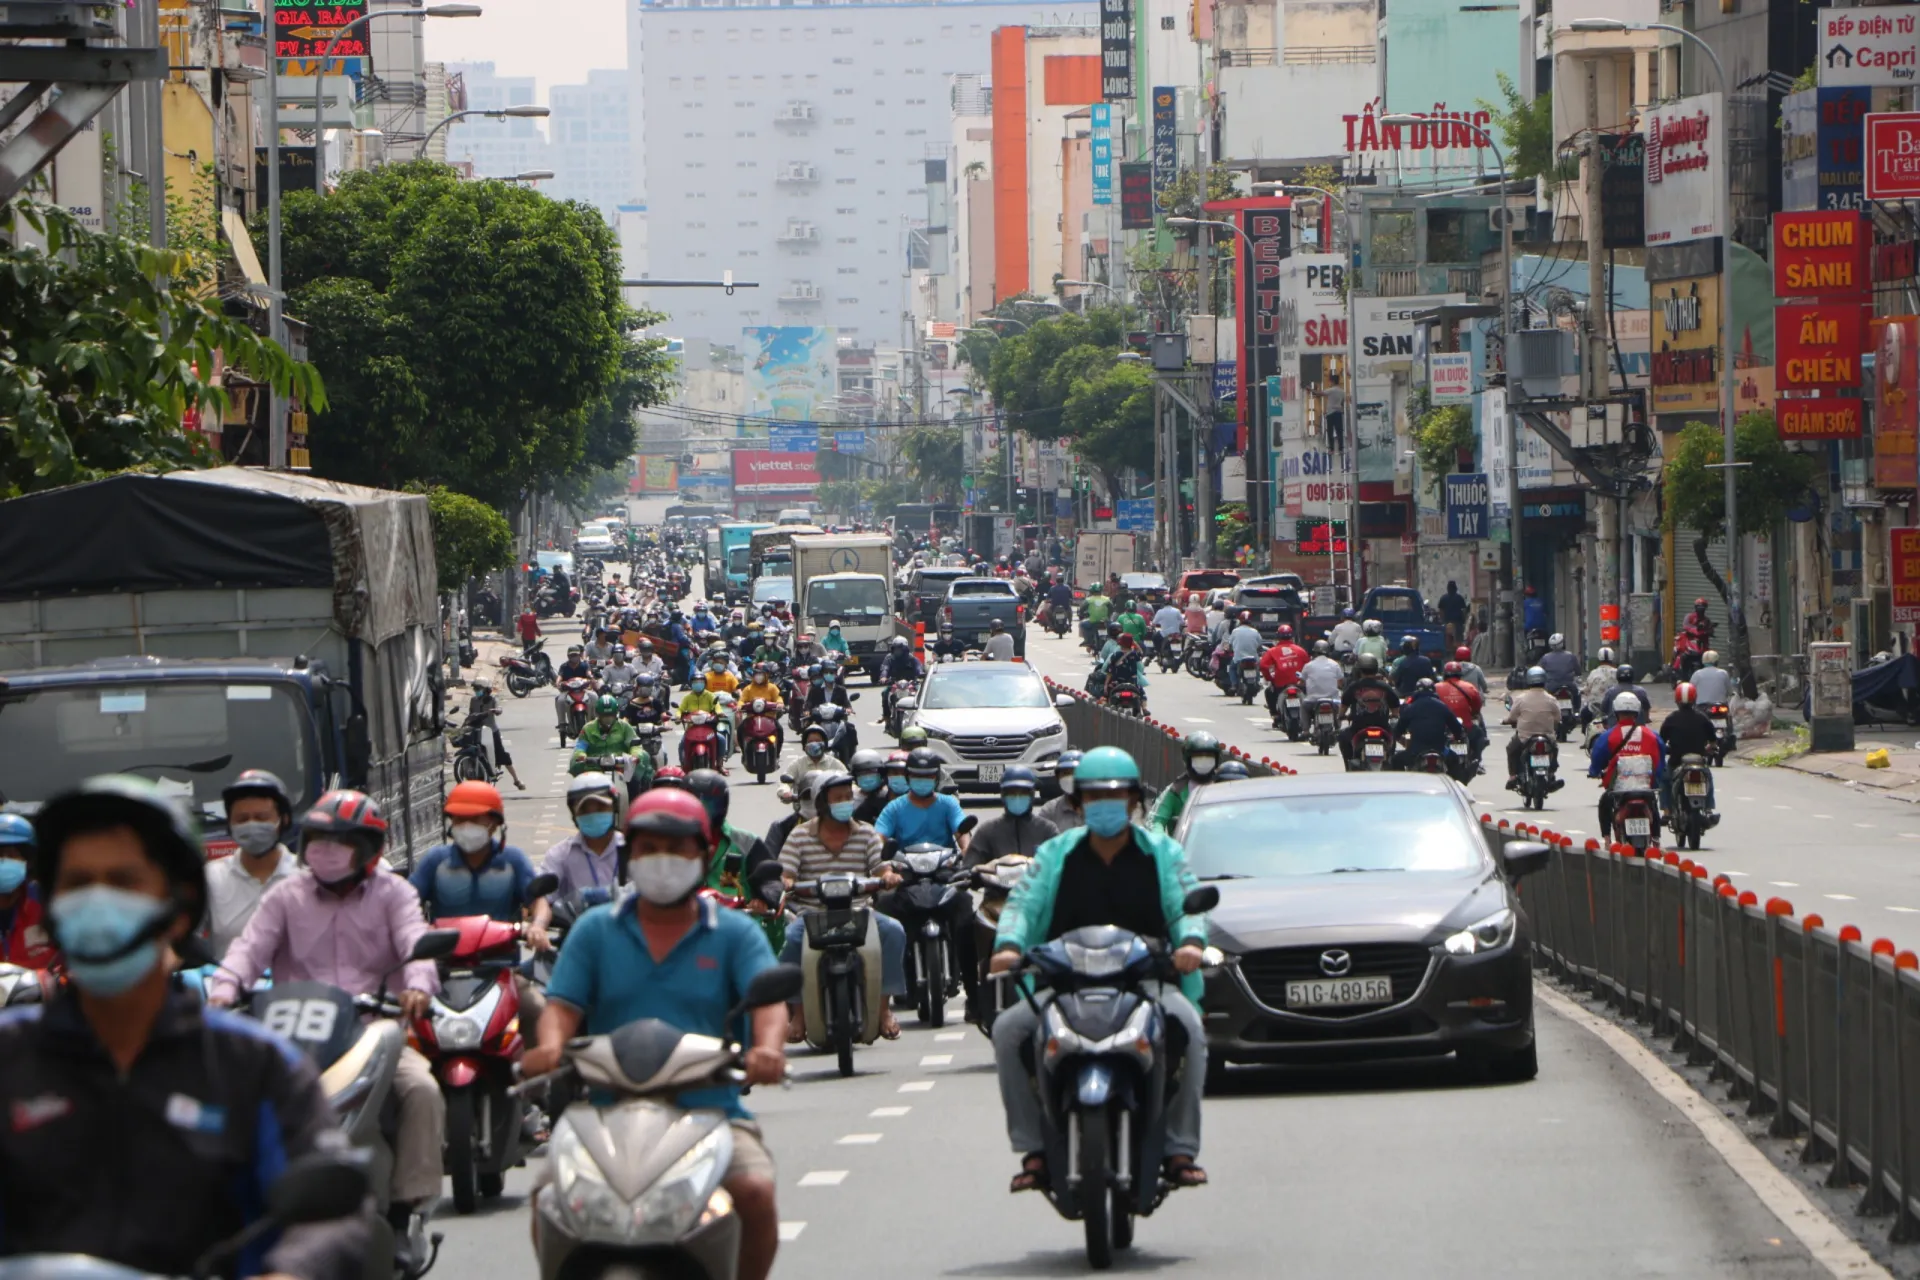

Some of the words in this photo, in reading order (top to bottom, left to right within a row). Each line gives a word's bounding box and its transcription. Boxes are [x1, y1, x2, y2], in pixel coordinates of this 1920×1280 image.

[275, 11, 313, 25] GIA
[318, 6, 360, 25] BẢO
[1828, 14, 1854, 37] BẾP
[1858, 15, 1892, 38] ĐIỆN
[1856, 45, 1916, 71] Capri
[1103, 77, 1129, 94] LONG
[1342, 95, 1402, 151] TẤN
[1410, 101, 1491, 150] DŨNG
[69, 206, 93, 216] 248
[1826, 192, 1864, 211] 345
[1782, 221, 1854, 248] CHUM
[1786, 256, 1853, 288] SÀNH
[1305, 314, 1348, 347] SÀN
[1799, 311, 1839, 345] ẤM
[1363, 333, 1413, 356] SÀN
[1786, 351, 1852, 383] CHÉN
[1449, 474, 1487, 506] THUỐC
[1457, 512, 1480, 535] TÂY
